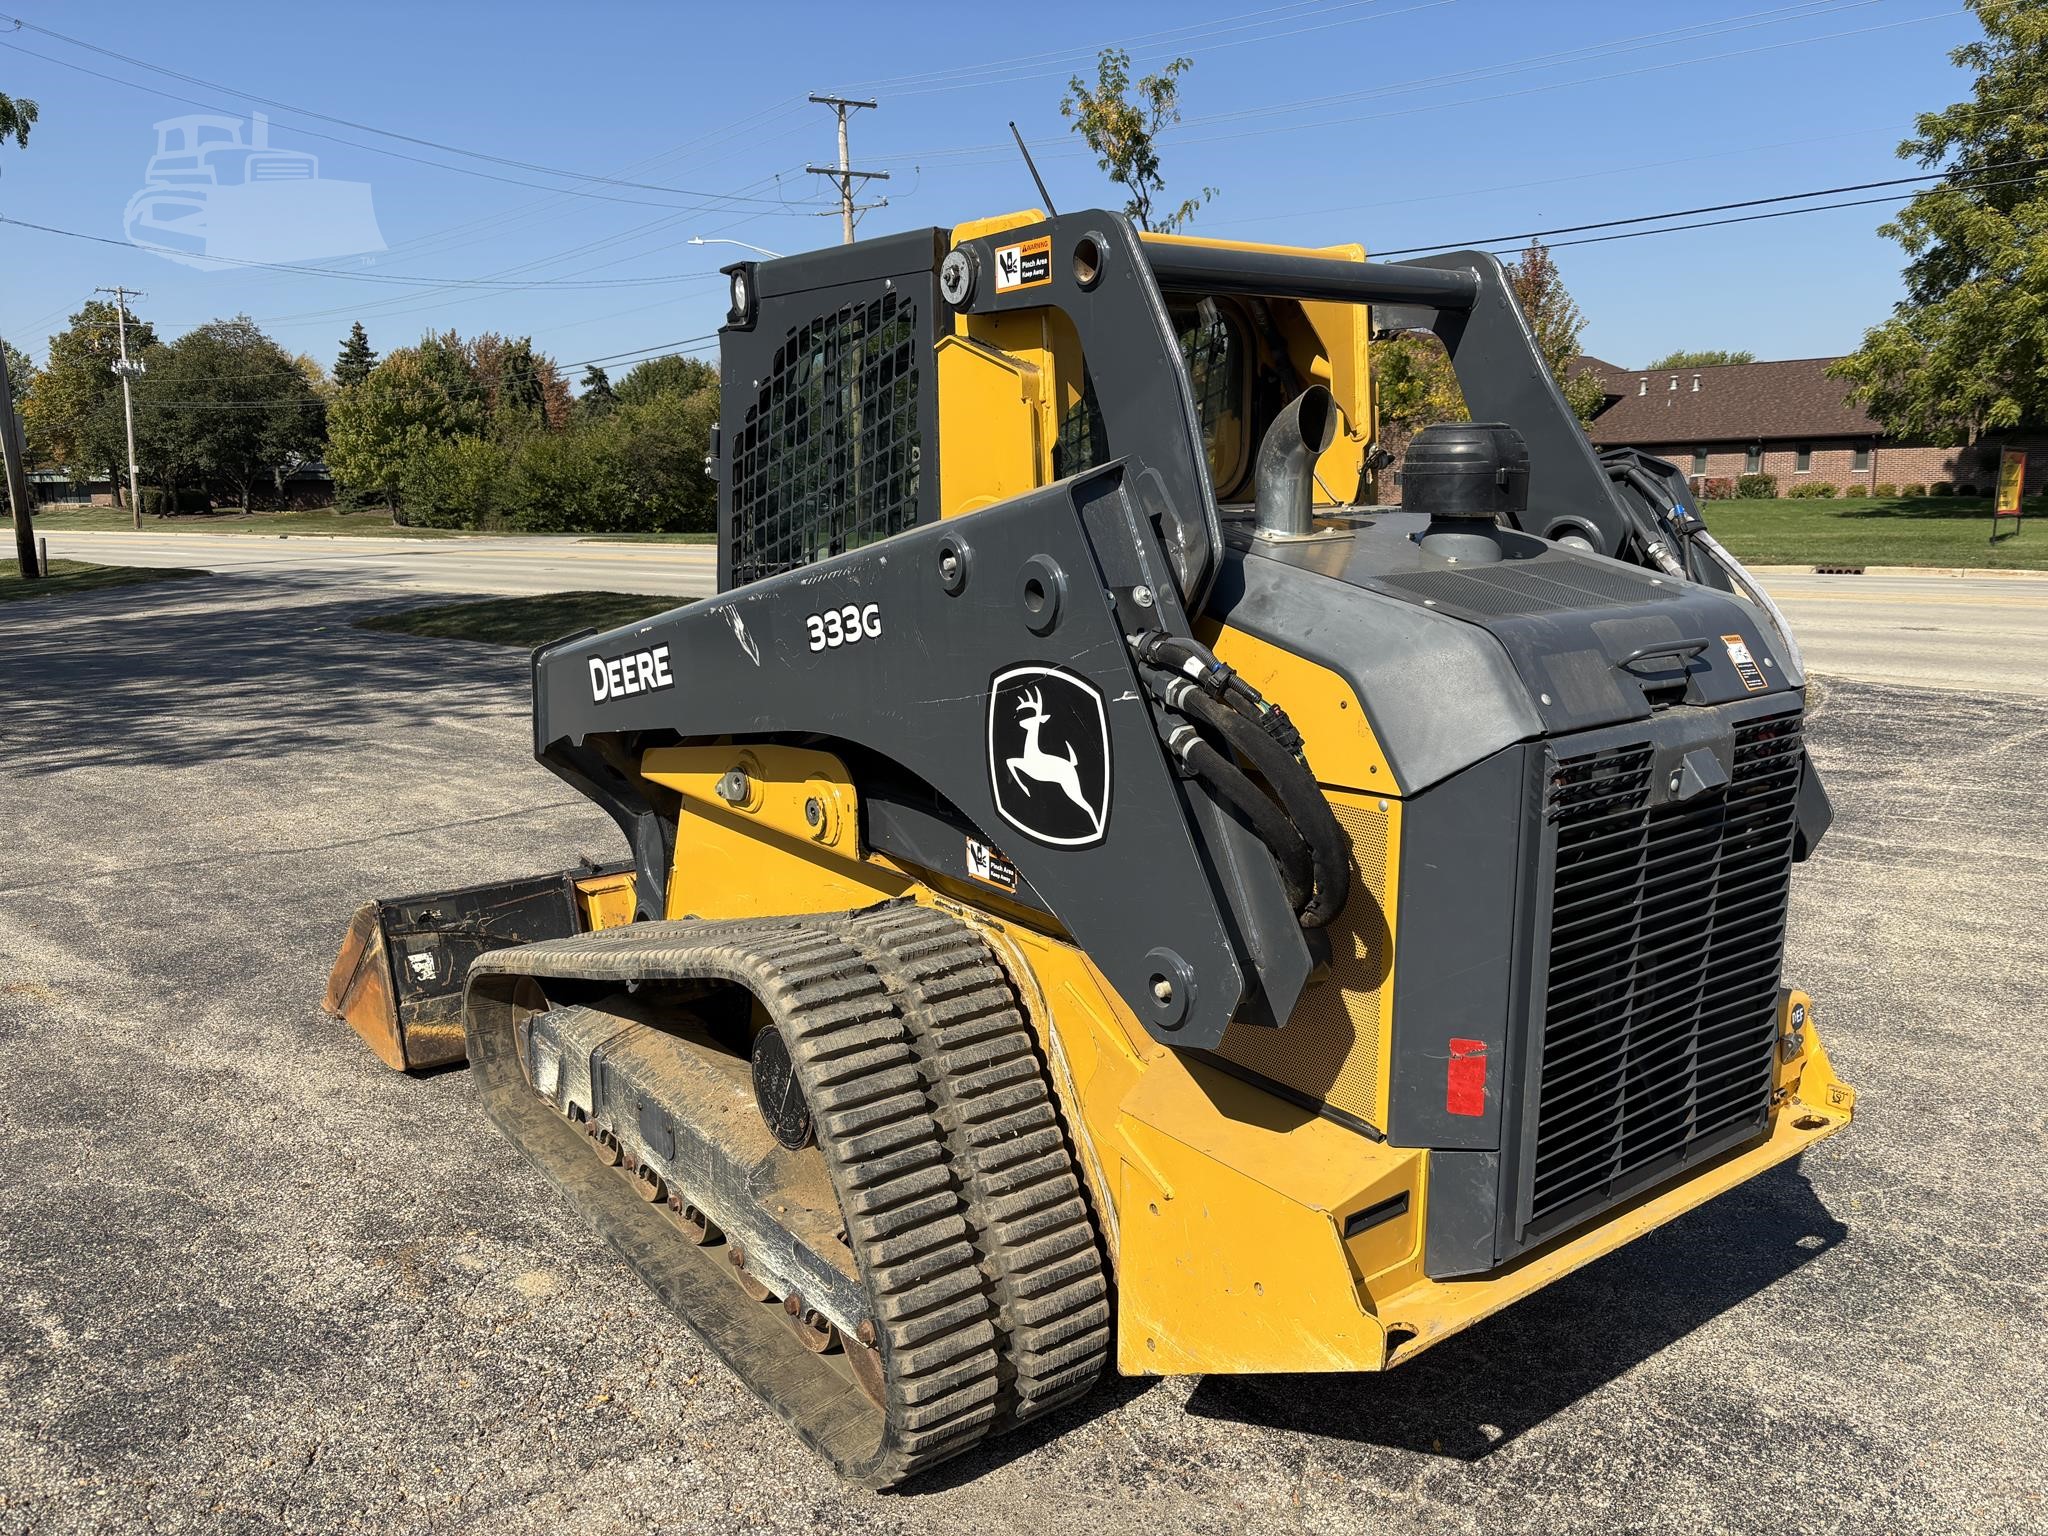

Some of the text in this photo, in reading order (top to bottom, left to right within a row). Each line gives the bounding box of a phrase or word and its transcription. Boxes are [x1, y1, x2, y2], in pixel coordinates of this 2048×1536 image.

[1026, 240, 1049, 251] WARNING
[1021, 258, 1048, 269] Pinch Area
[1033, 268, 1044, 276] Away
[806, 603, 882, 651] 333G
[588, 645, 673, 702] DEERE
[990, 861, 1014, 876] Pinch Area
